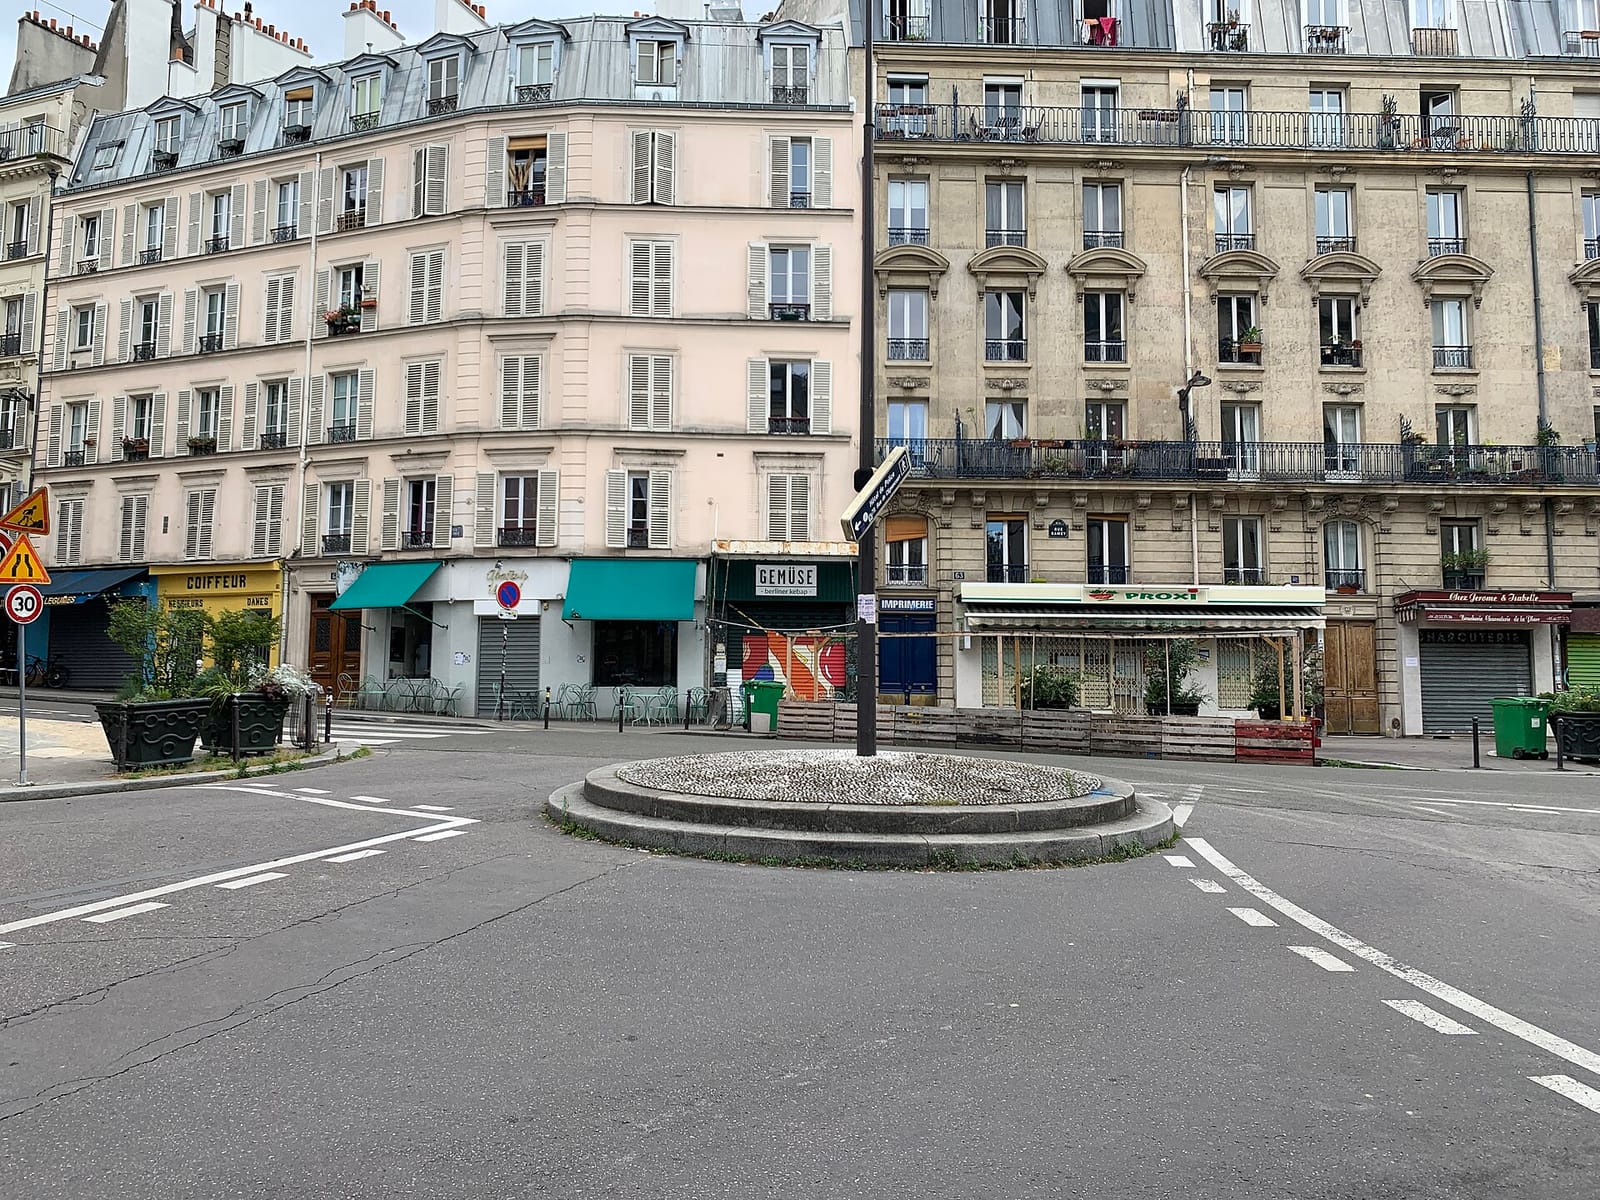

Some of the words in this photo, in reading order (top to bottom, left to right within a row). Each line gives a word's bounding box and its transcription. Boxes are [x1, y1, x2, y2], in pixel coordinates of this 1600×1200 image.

[760, 566, 813, 585] GEMÜSE
[187, 575, 247, 589] COIFFEUR
[789, 588, 808, 596] kebap
[1125, 588, 1197, 600] PROXI
[1449, 592, 1468, 601] Chez
[14, 596, 35, 612] 30
[247, 597, 269, 606] DAMES
[881, 599, 934, 609] IMPRIMERIE
